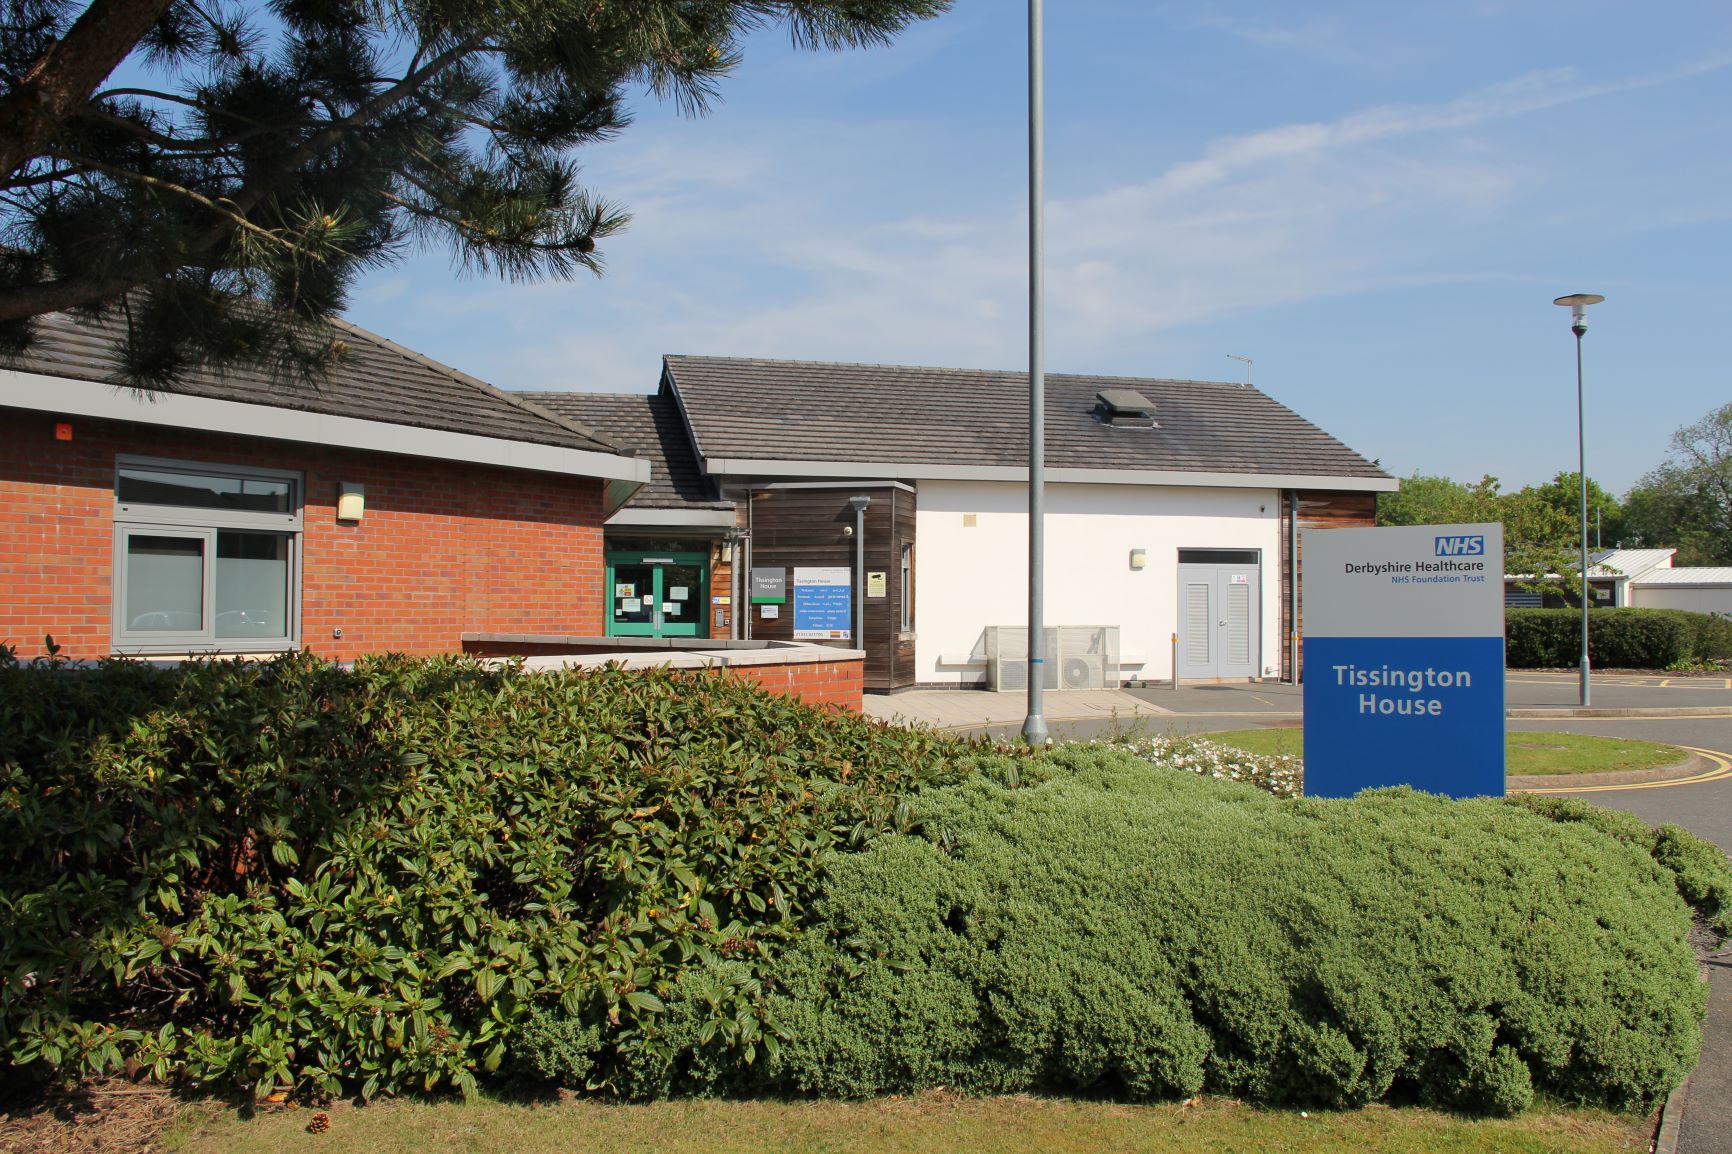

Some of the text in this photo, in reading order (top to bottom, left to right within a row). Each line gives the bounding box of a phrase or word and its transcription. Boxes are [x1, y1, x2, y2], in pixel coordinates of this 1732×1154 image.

[1436, 537, 1483, 555] NHS
[1345, 560, 1484, 575] Derbyshire Healthcare
[1391, 574, 1485, 584] NHS Foundation Trust
[1332, 665, 1471, 693] Tissington
[1359, 694, 1443, 716] House
